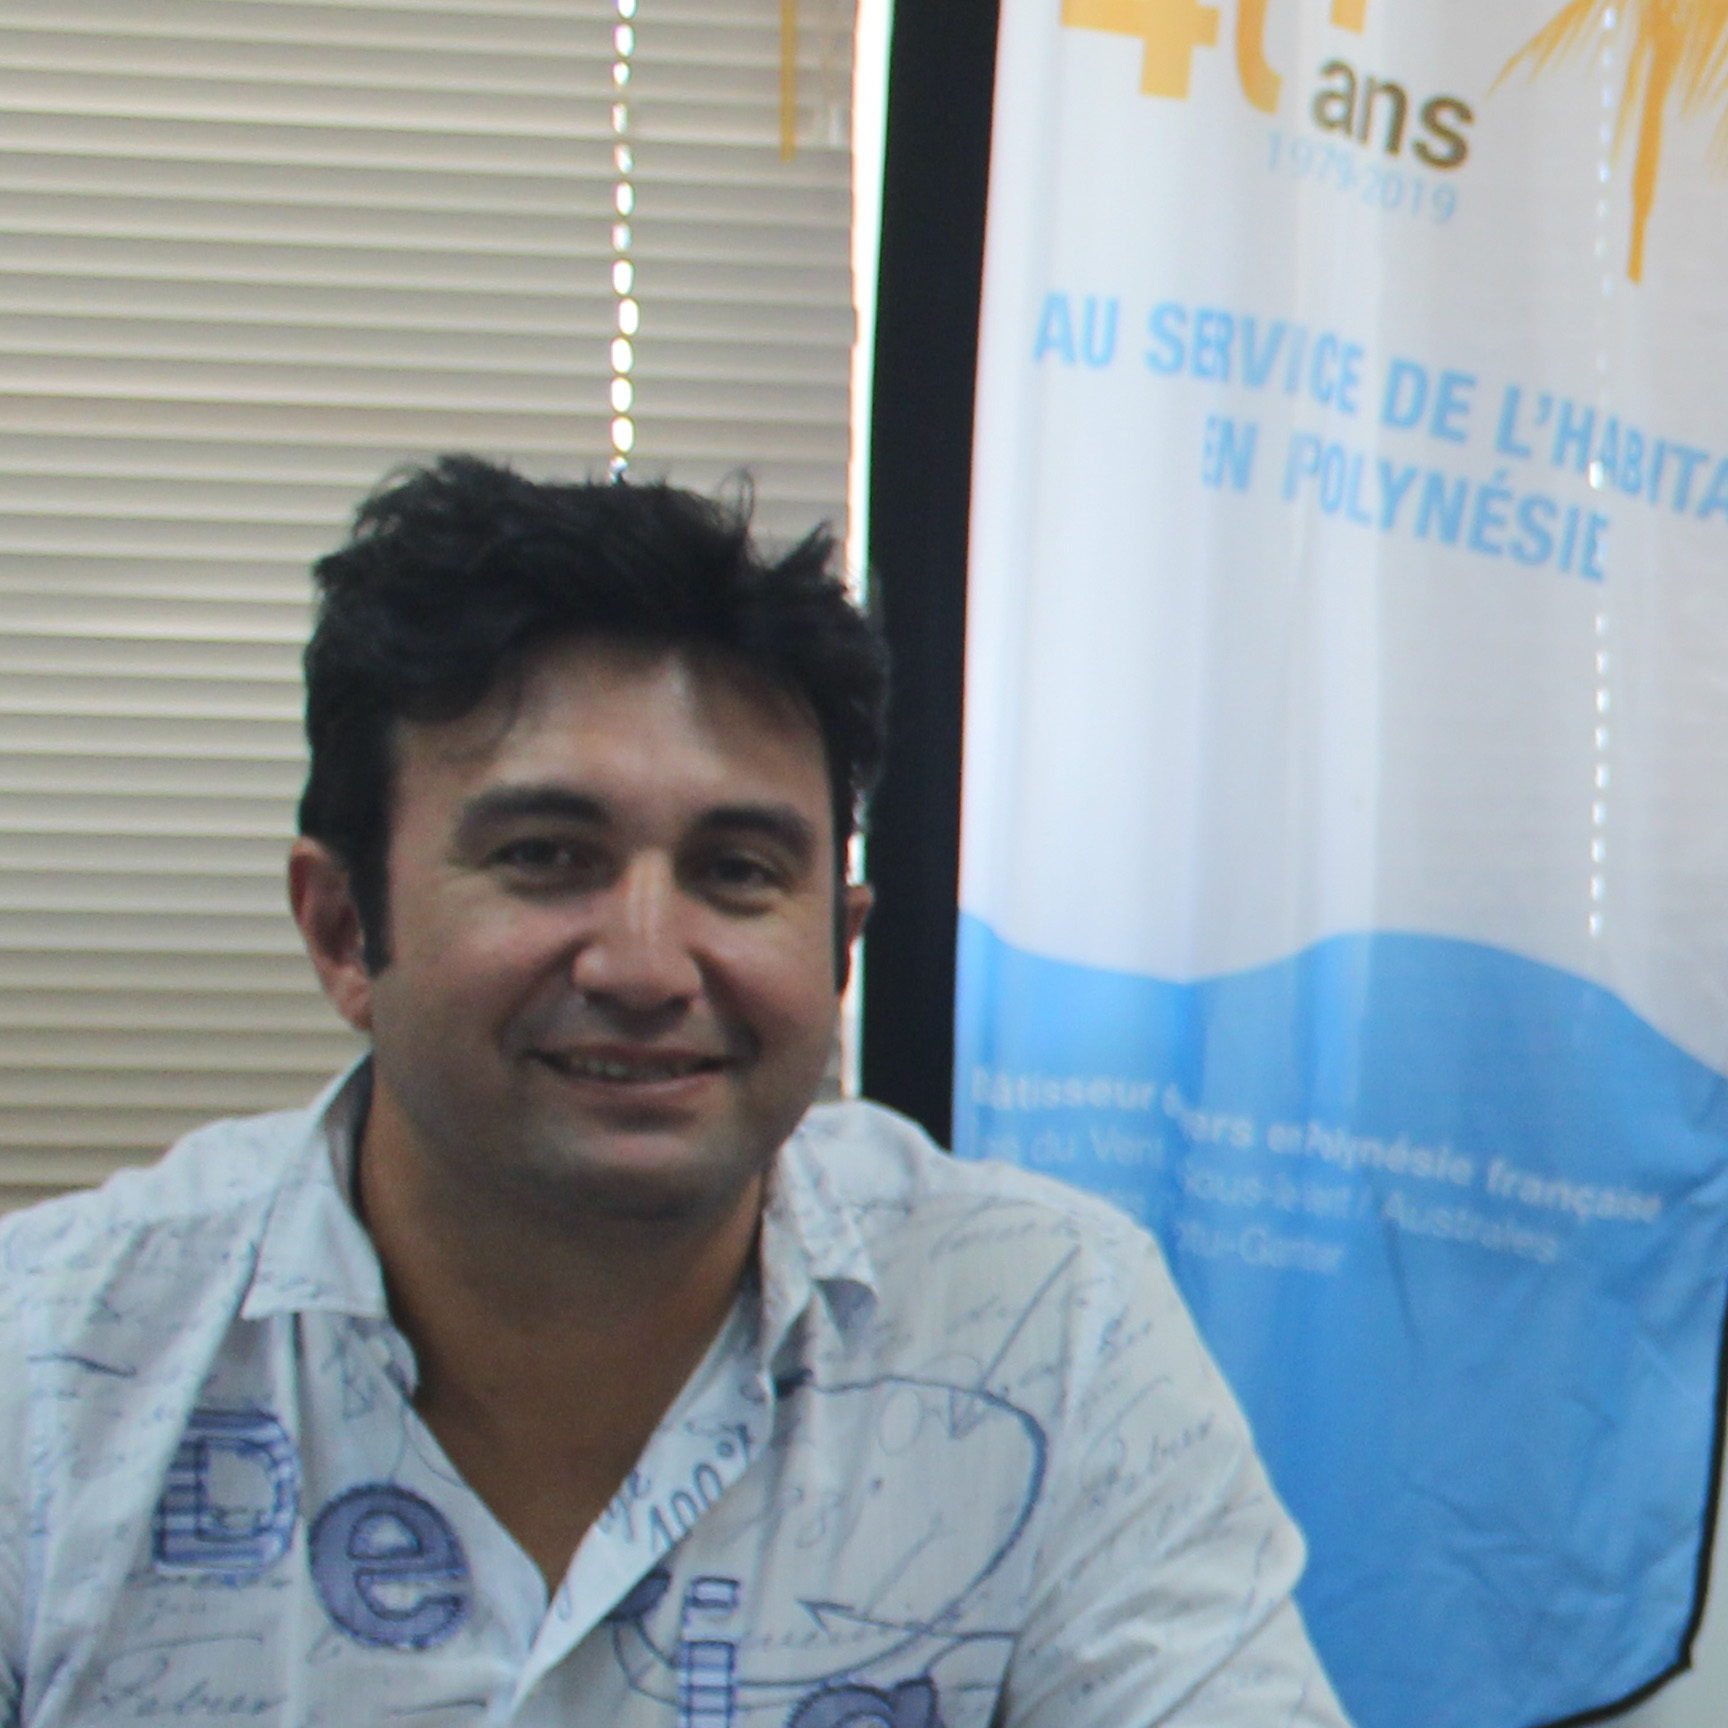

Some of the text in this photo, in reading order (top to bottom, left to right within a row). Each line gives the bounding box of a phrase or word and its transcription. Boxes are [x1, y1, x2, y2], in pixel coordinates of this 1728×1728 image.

[1310, 56, 1476, 171] ans
[1034, 290, 1120, 367] AU
[1147, 300, 1363, 414] SERVICE
[1379, 357, 1475, 444] DE
[1282, 430, 1609, 583] POLYNÉSIE
